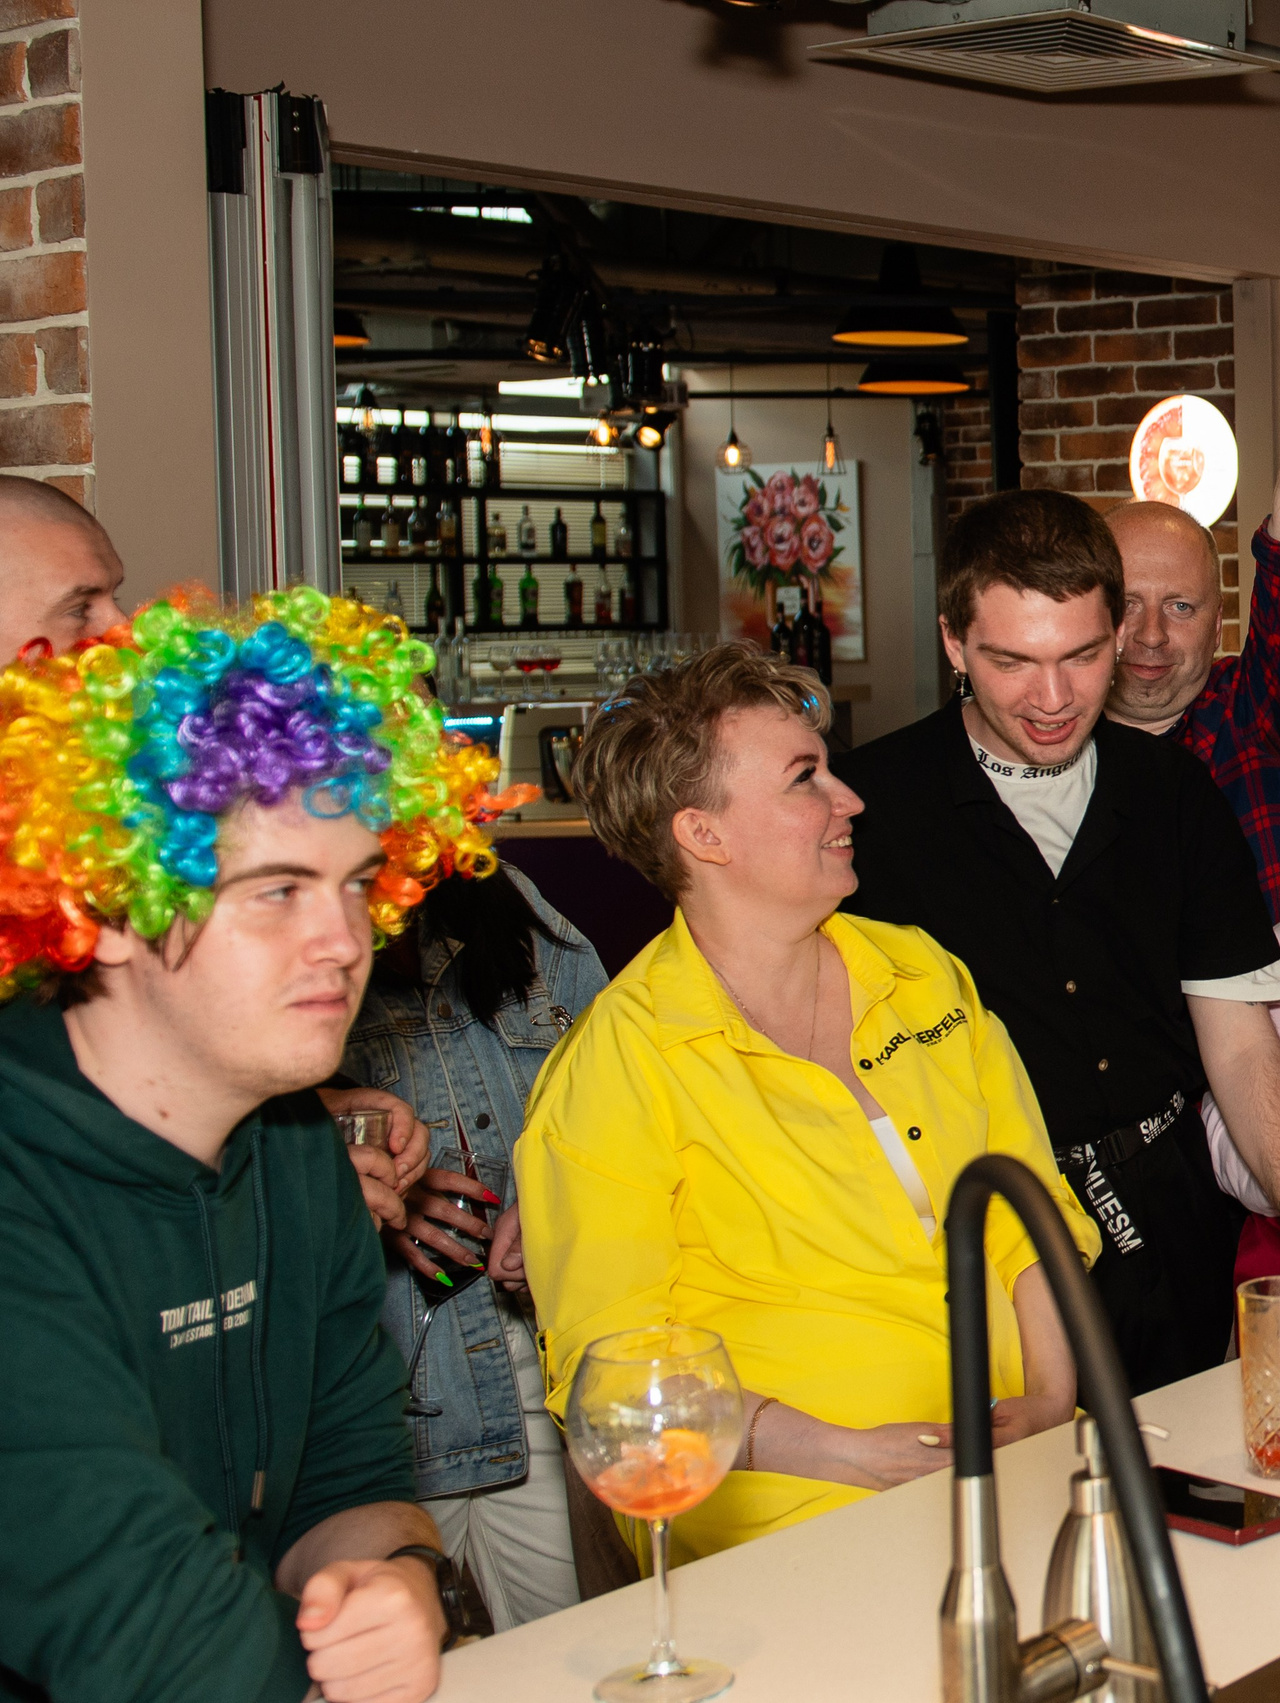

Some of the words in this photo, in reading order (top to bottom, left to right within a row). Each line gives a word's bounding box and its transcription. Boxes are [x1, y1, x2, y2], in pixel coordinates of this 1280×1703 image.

[977, 748, 1014, 776] Los
[875, 1032, 912, 1065] KARL
[160, 1306, 186, 1333] TOM
